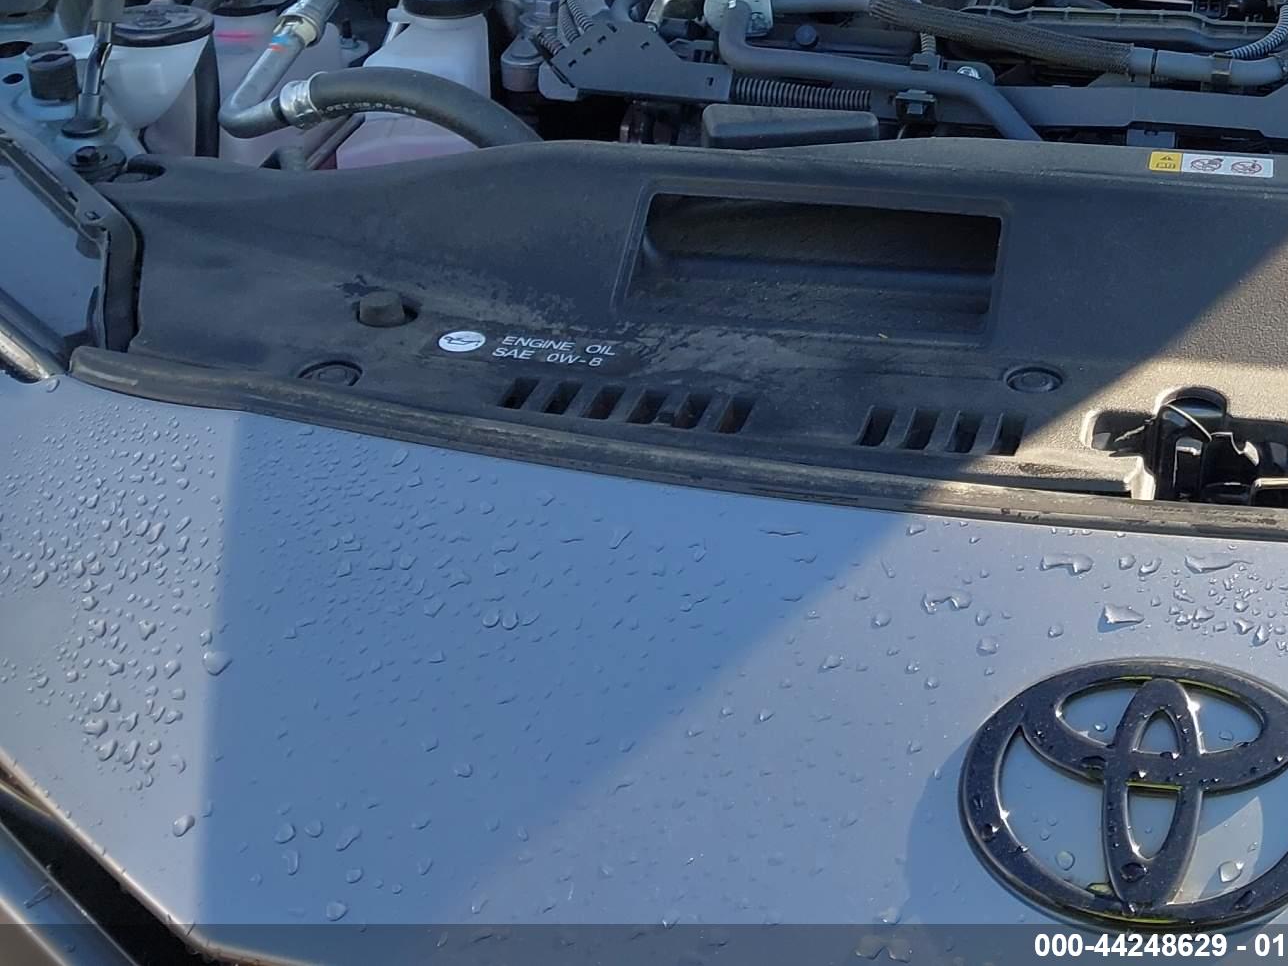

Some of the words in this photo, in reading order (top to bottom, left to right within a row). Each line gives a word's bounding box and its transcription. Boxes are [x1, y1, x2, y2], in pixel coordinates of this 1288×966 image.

[492, 347, 535, 360] SAE
[501, 335, 577, 352] ENGINE
[585, 344, 617, 356] OIL
